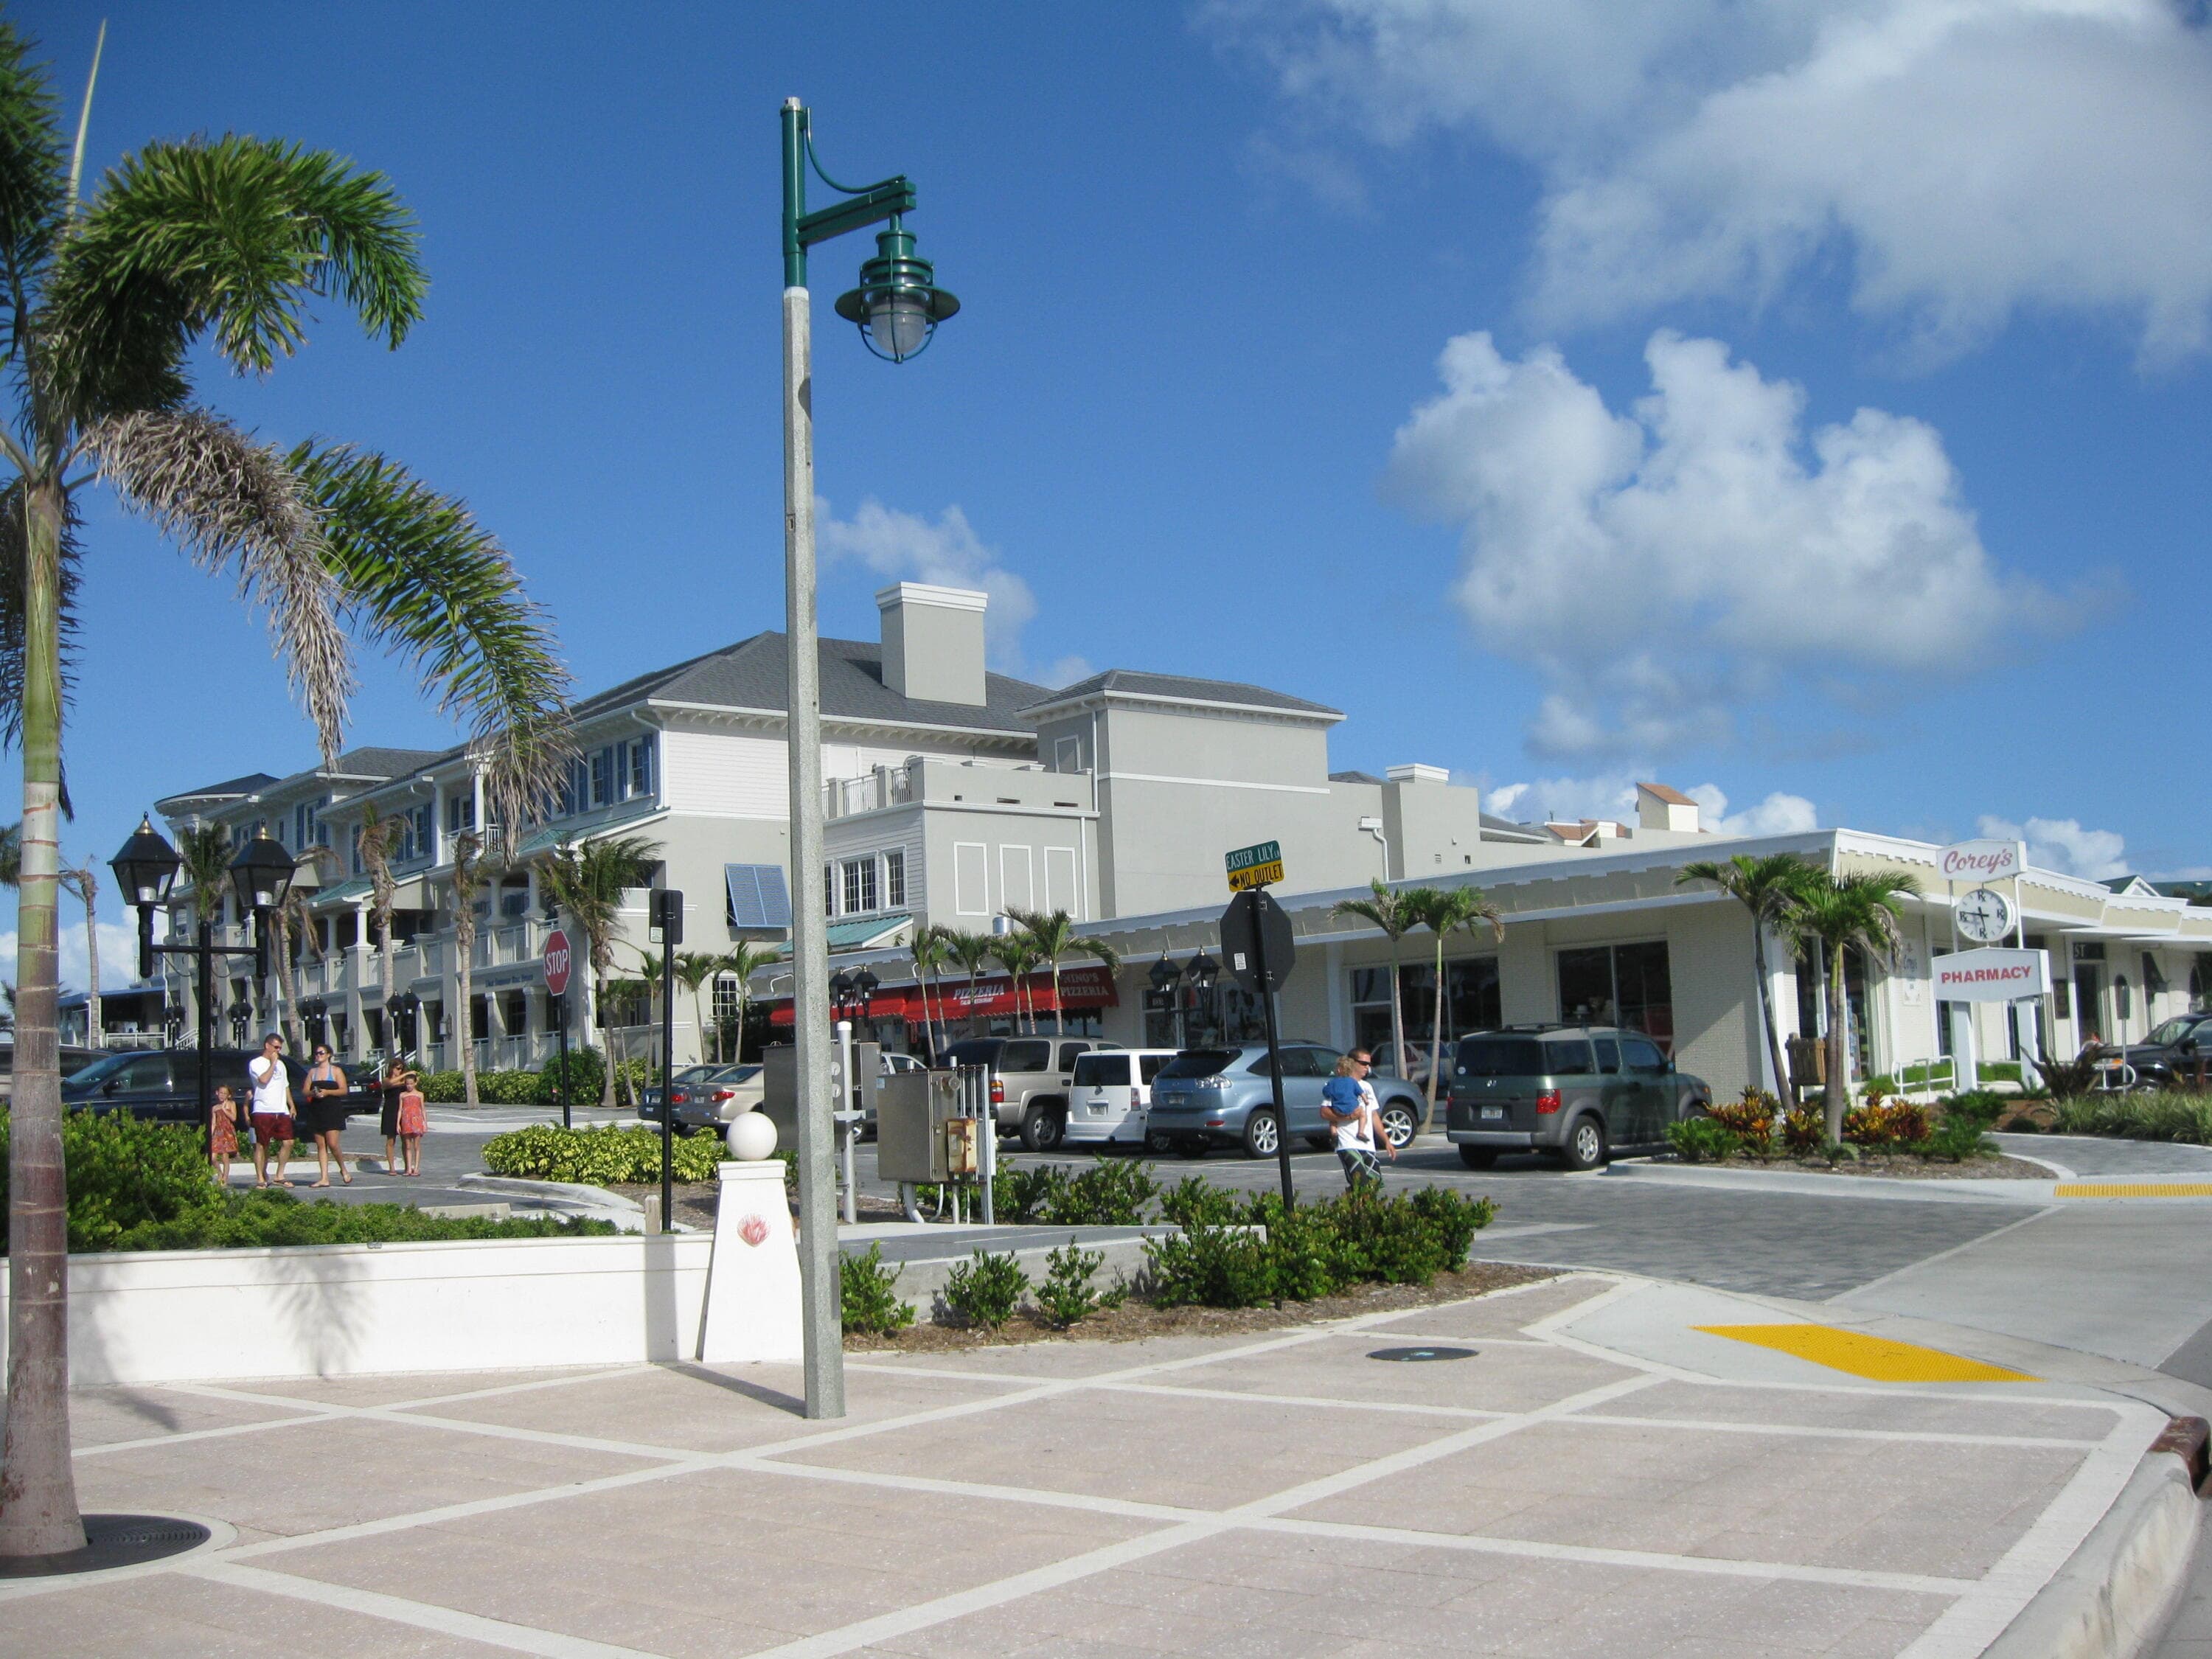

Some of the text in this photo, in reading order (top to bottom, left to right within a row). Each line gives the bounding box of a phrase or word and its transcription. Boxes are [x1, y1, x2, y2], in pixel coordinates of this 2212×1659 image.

[1225, 849, 1254, 870] EASTER
[1258, 844, 1274, 862] LILY
[1944, 848, 2014, 874] Corey's
[1239, 863, 1283, 888] NO OUTLET
[546, 949, 568, 976] STOP
[1941, 965, 2032, 984] PHARMACY
[953, 984, 1005, 1001] PIZZERIA
[1060, 985, 1110, 997] PIZZERIA
